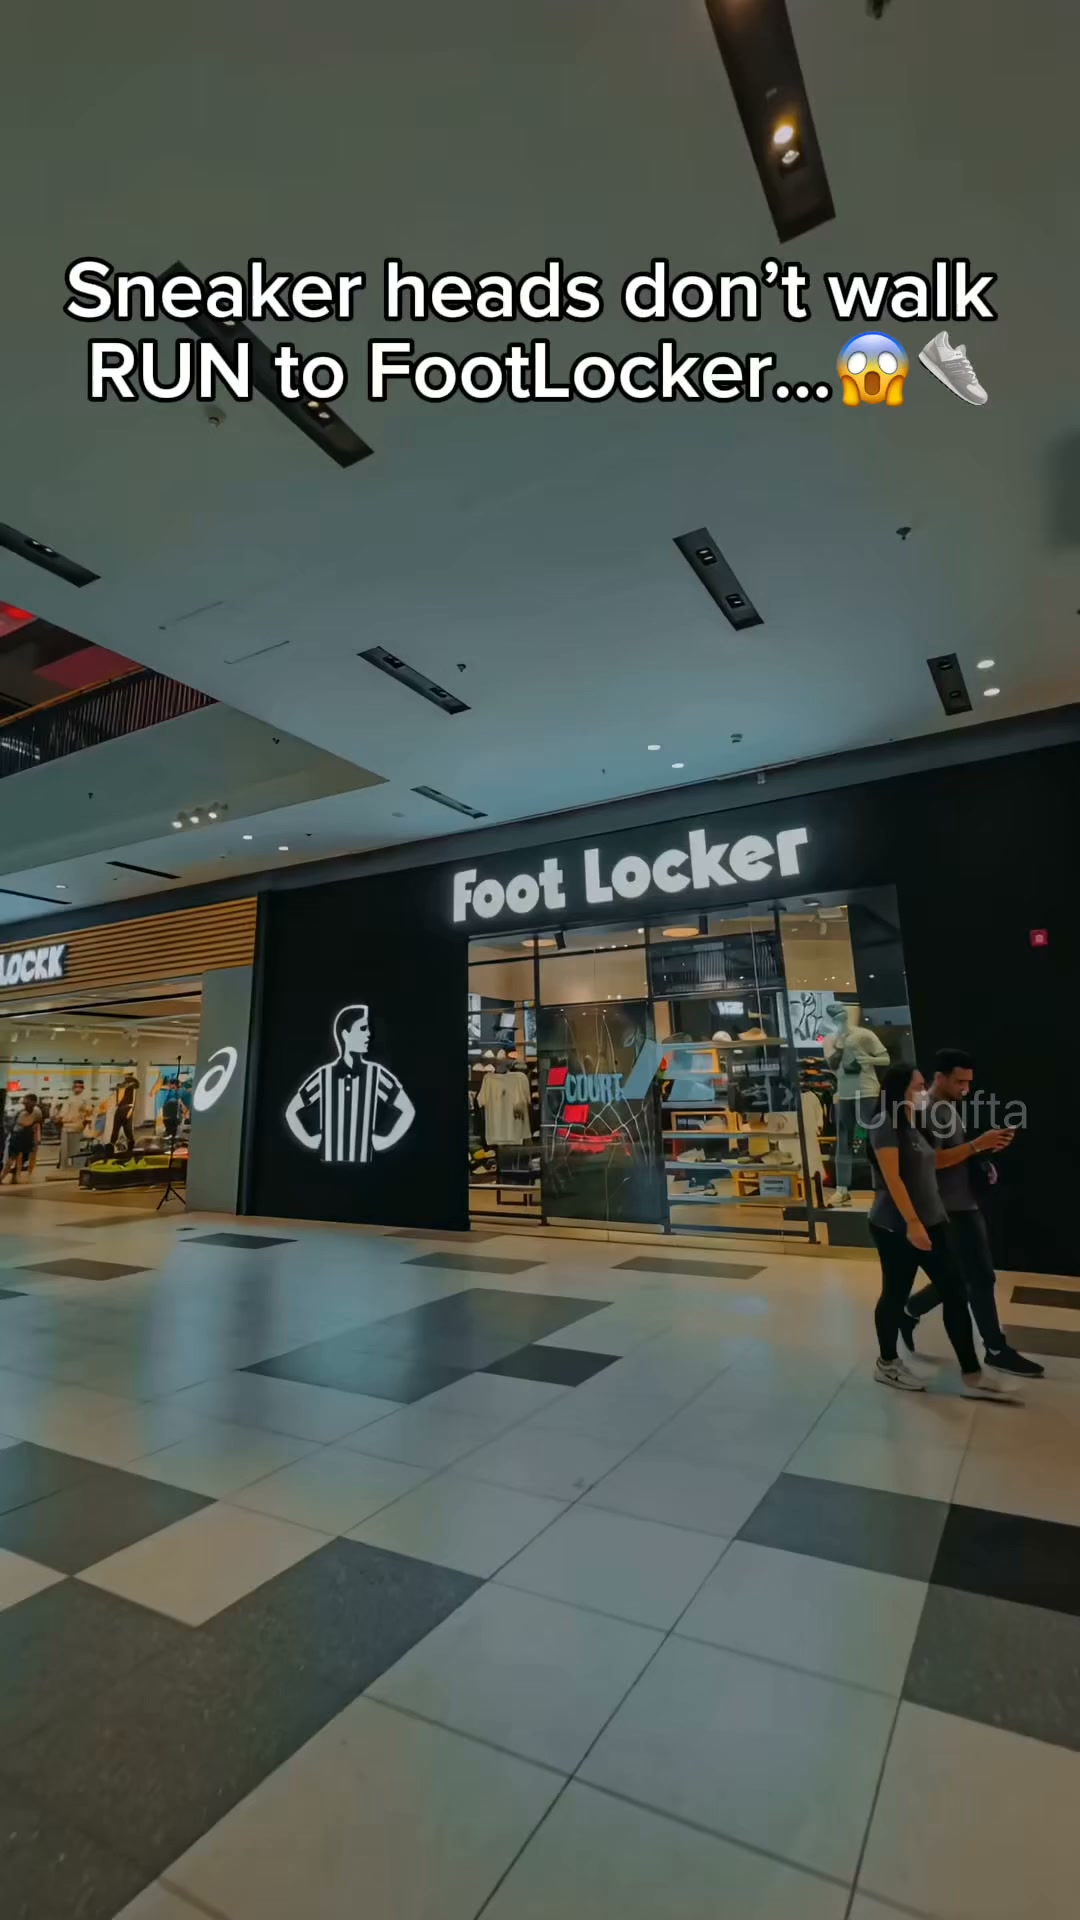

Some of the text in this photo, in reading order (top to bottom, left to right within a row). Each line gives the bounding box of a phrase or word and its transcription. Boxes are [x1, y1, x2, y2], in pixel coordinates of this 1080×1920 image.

[453, 828, 809, 923] Foot Locker
[564, 1073, 624, 1104] COURT
